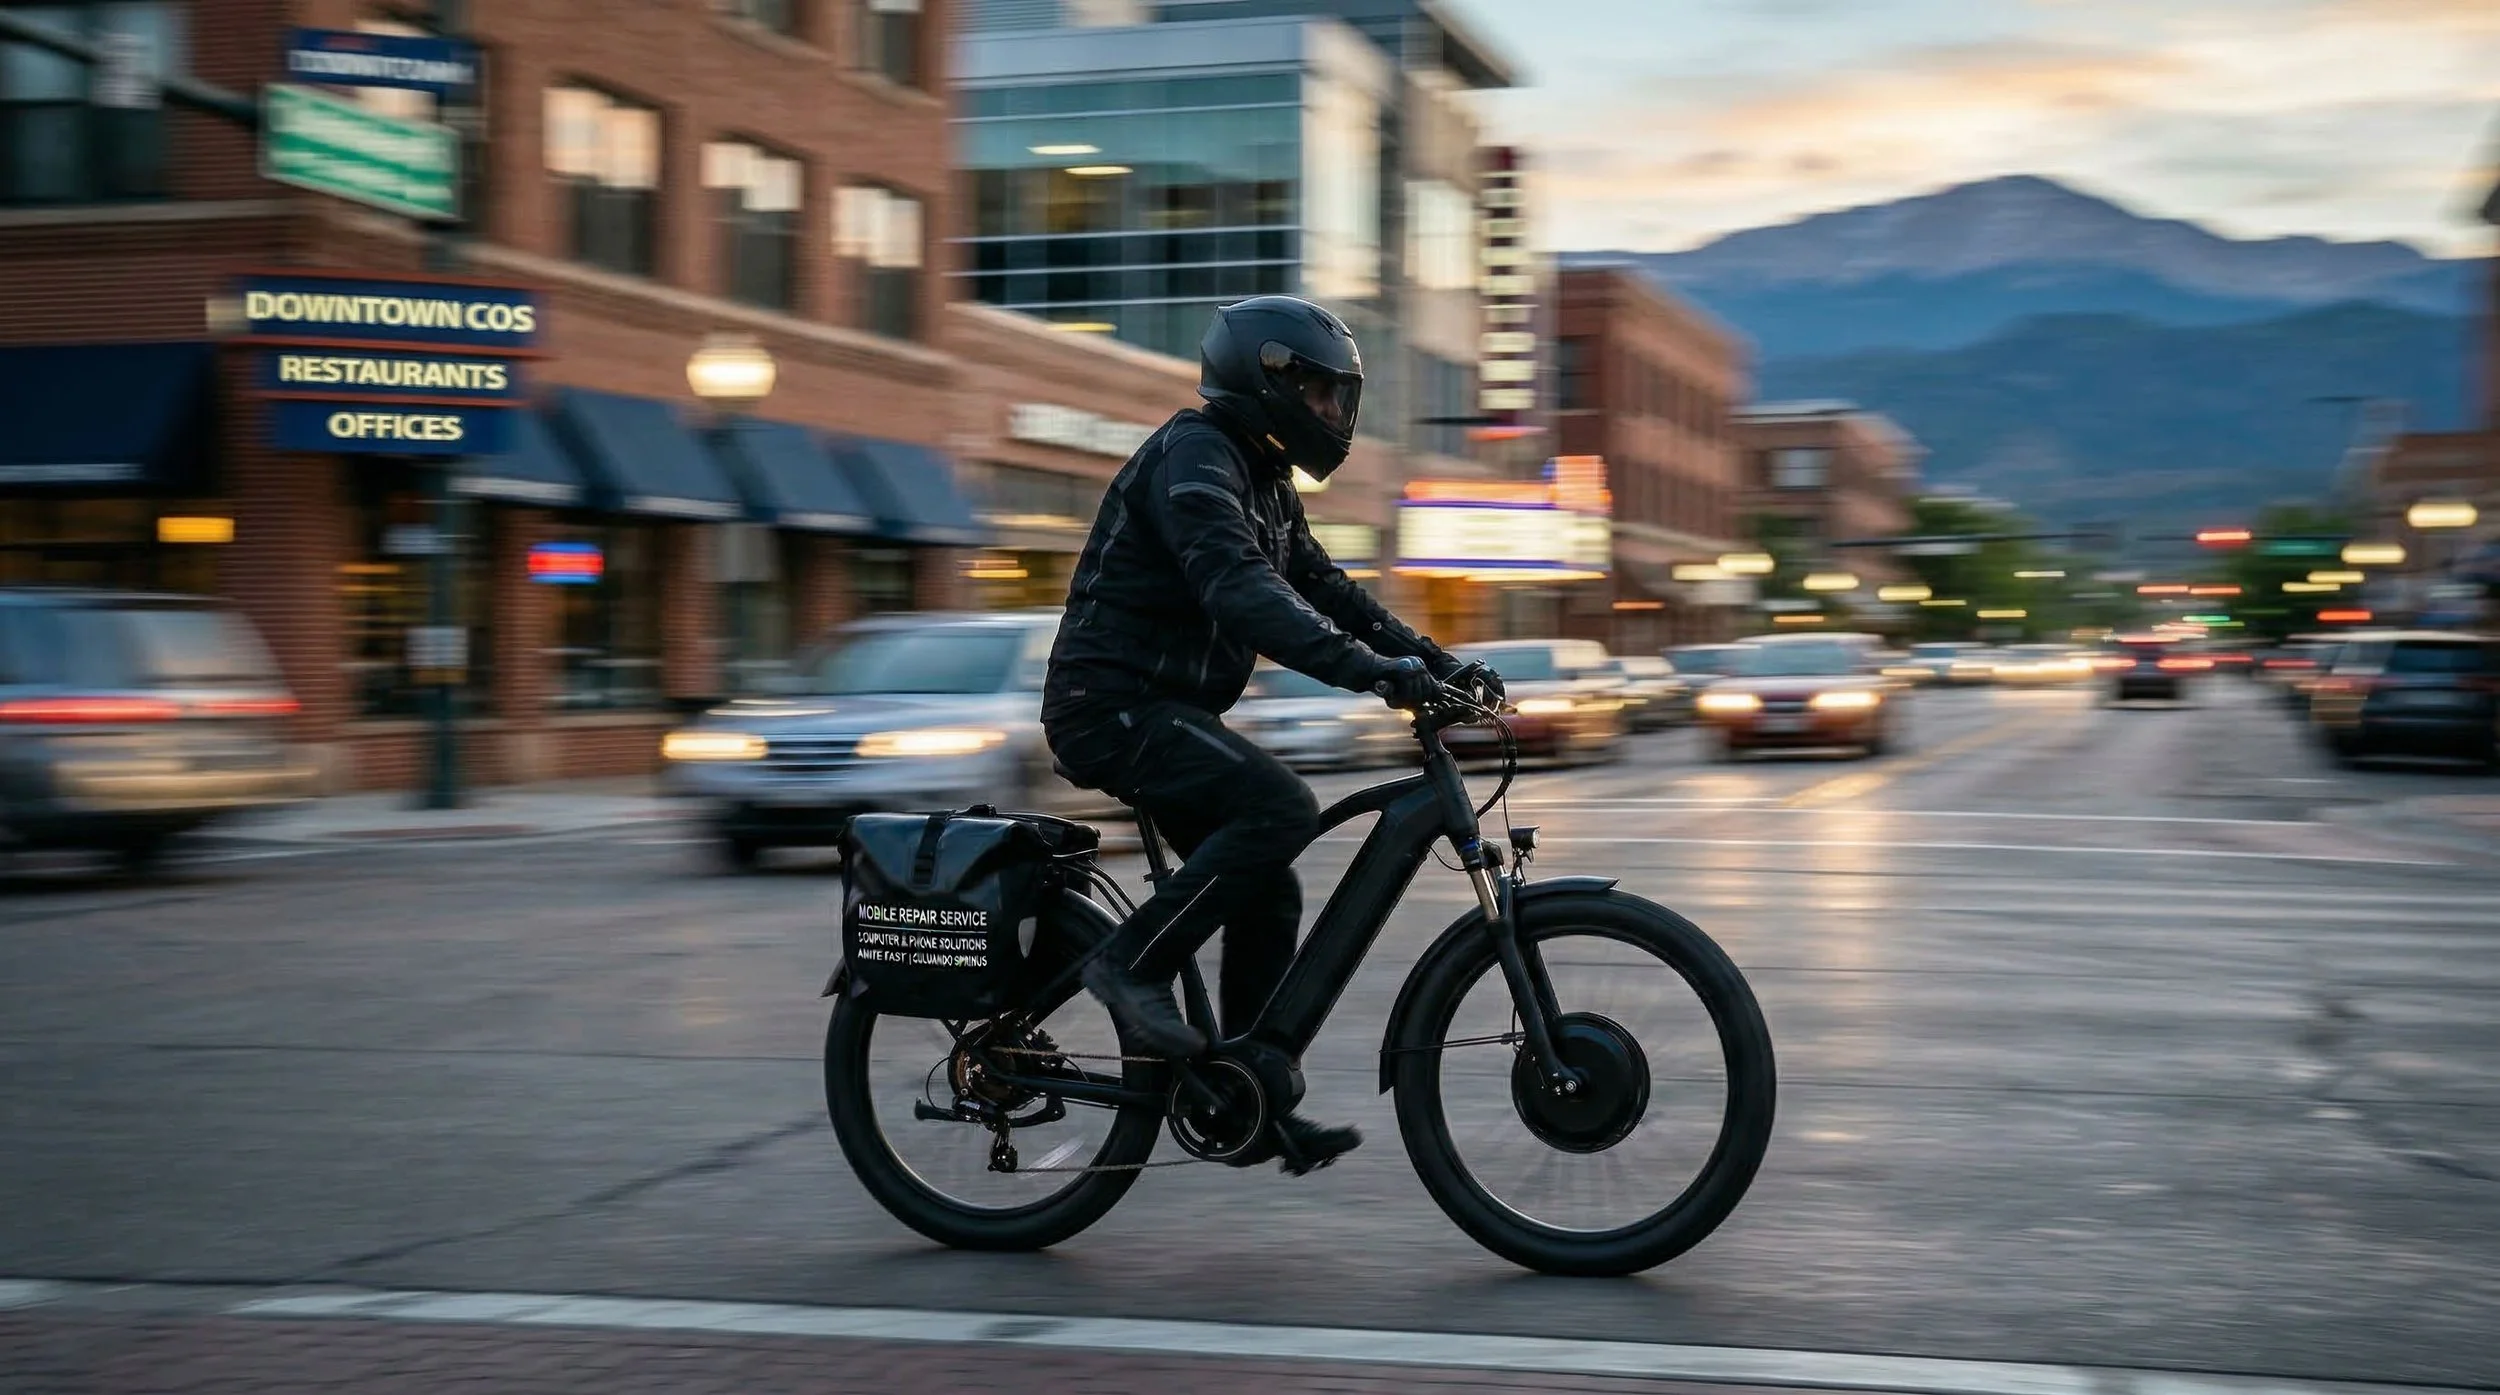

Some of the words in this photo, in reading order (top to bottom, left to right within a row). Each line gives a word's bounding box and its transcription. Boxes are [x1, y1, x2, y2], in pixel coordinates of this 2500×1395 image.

[246, 291, 462, 328] DOWNTOWN
[465, 302, 535, 333] COS
[279, 355, 508, 390] RESTAURANTS
[328, 411, 463, 441] OFFICES
[858, 903, 898, 922] MOBILE
[899, 907, 937, 925] REPAIR
[940, 910, 987, 926] SERVICE
